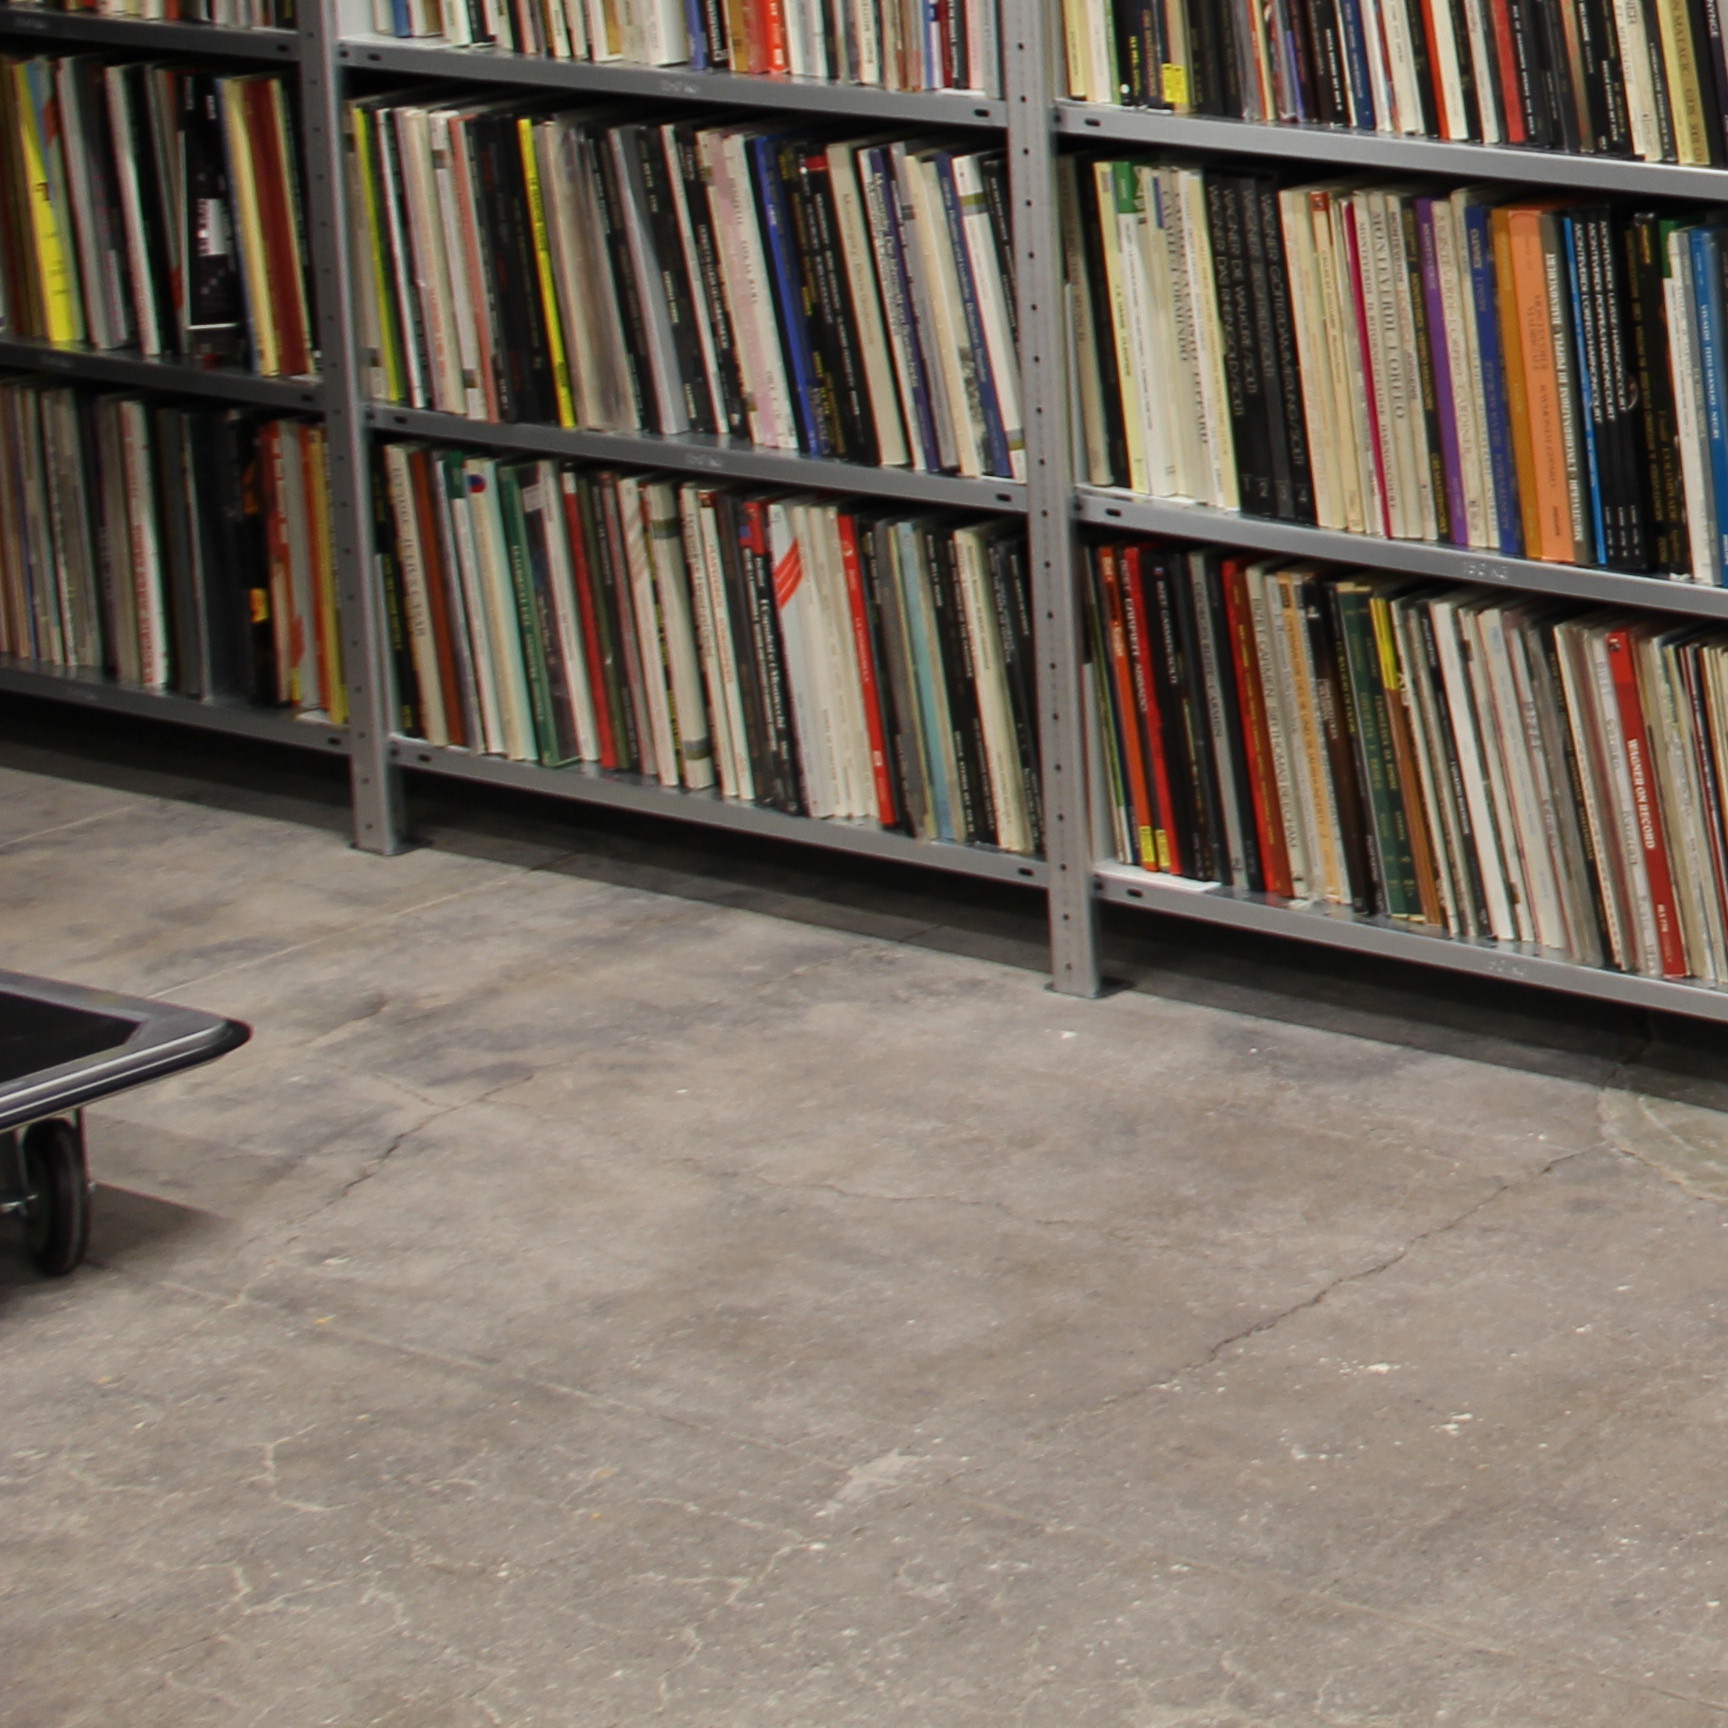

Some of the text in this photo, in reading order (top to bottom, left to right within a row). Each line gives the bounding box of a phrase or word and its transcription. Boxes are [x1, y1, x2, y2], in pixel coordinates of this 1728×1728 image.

[1627, 739, 1656, 849] WAGNER ON RECORD
